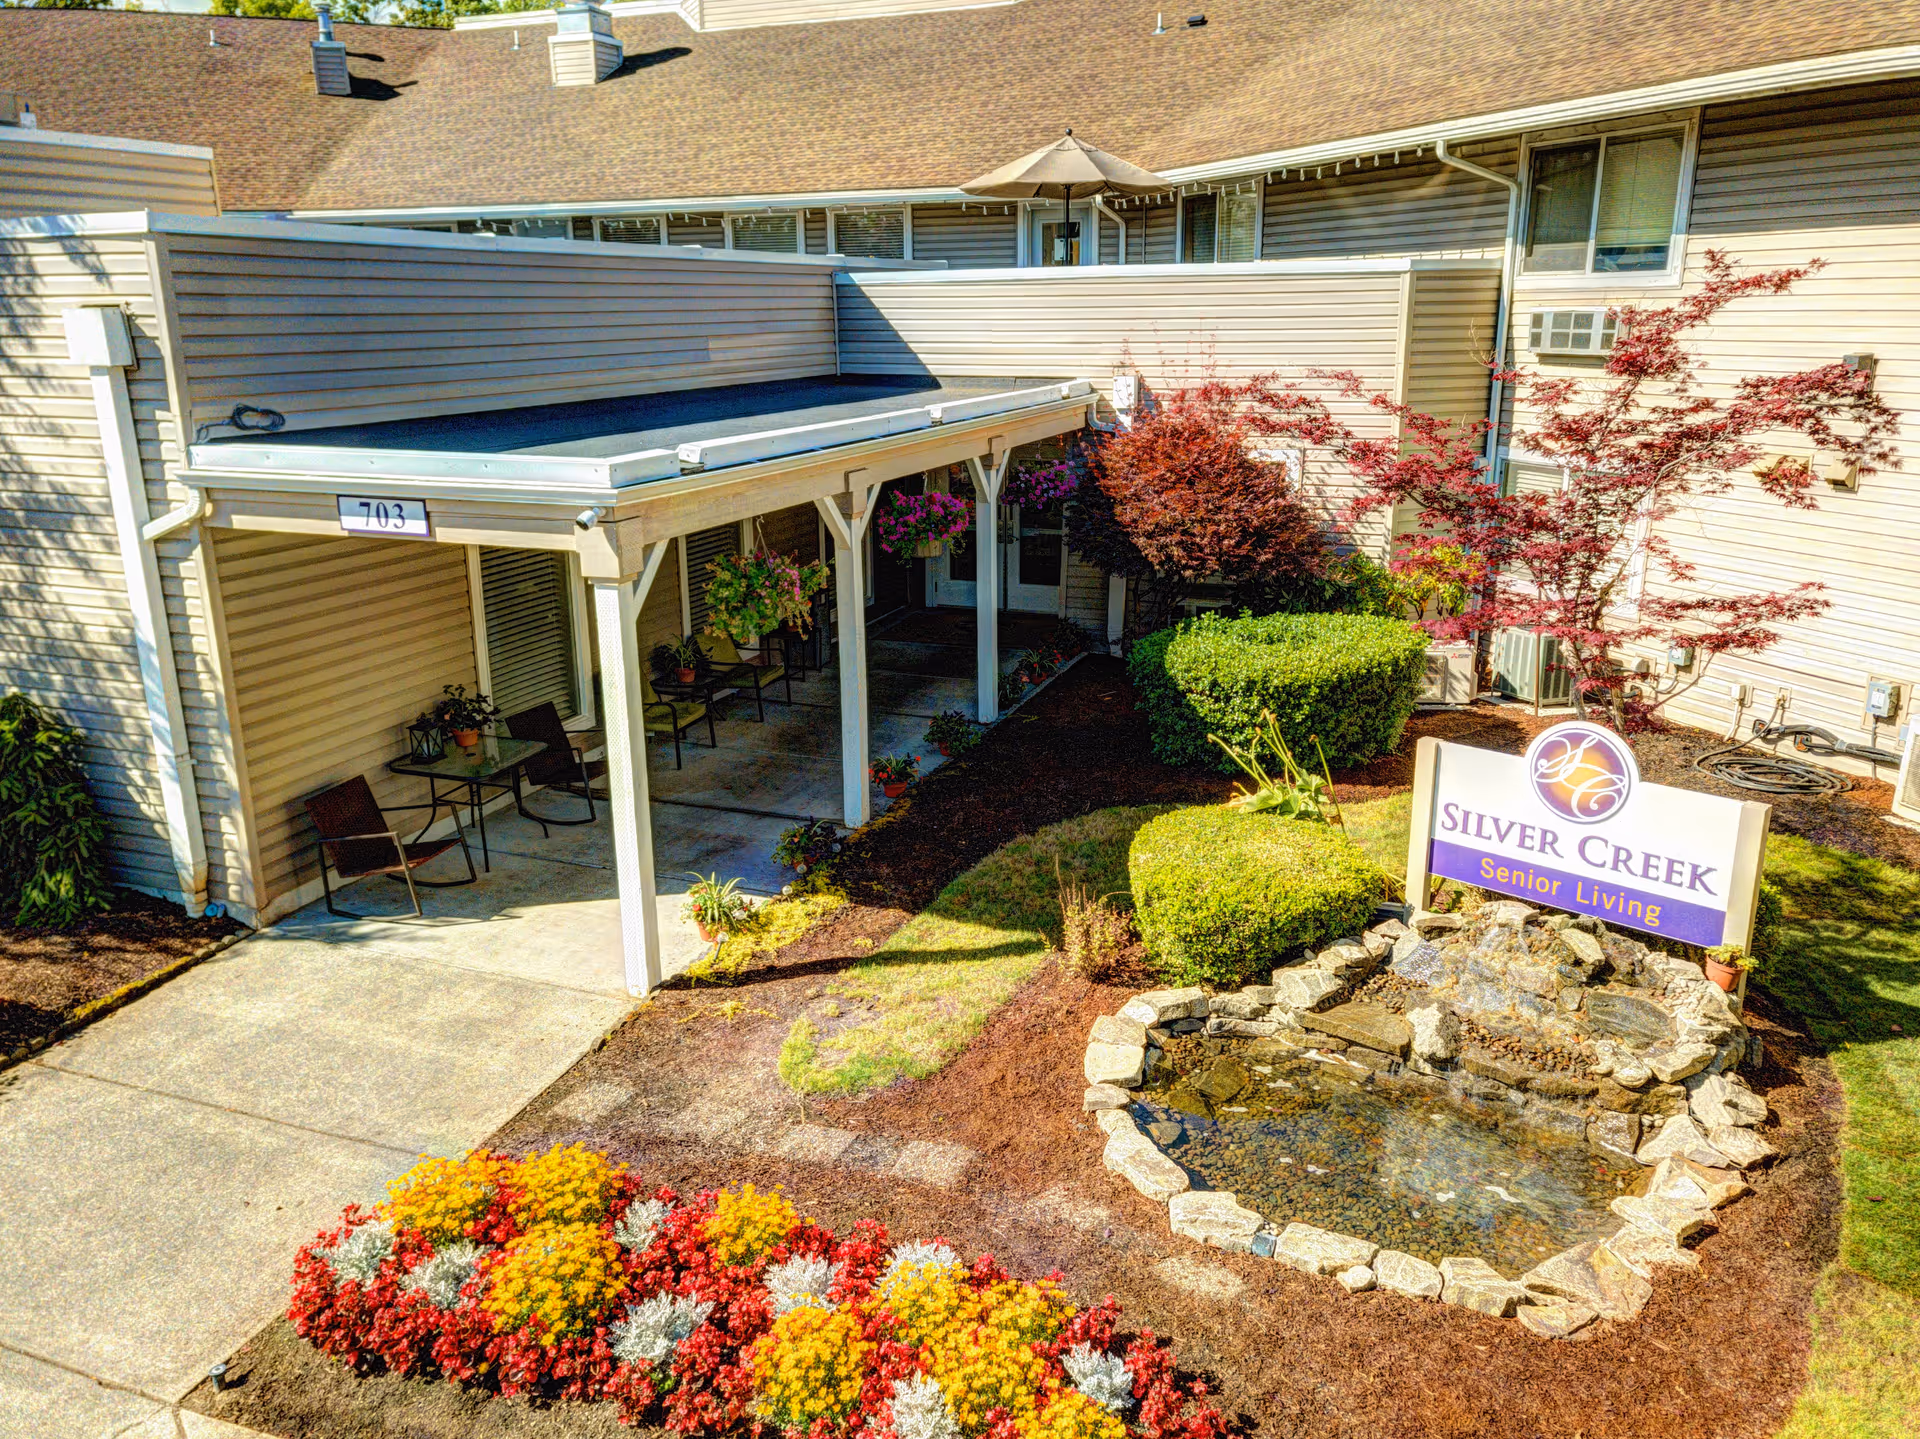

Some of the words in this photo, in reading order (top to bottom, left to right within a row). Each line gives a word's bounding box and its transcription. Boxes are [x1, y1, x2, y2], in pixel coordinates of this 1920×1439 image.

[359, 502, 406, 529] 703
[1480, 857, 1562, 896] Senior
[1576, 881, 1663, 927] Living
